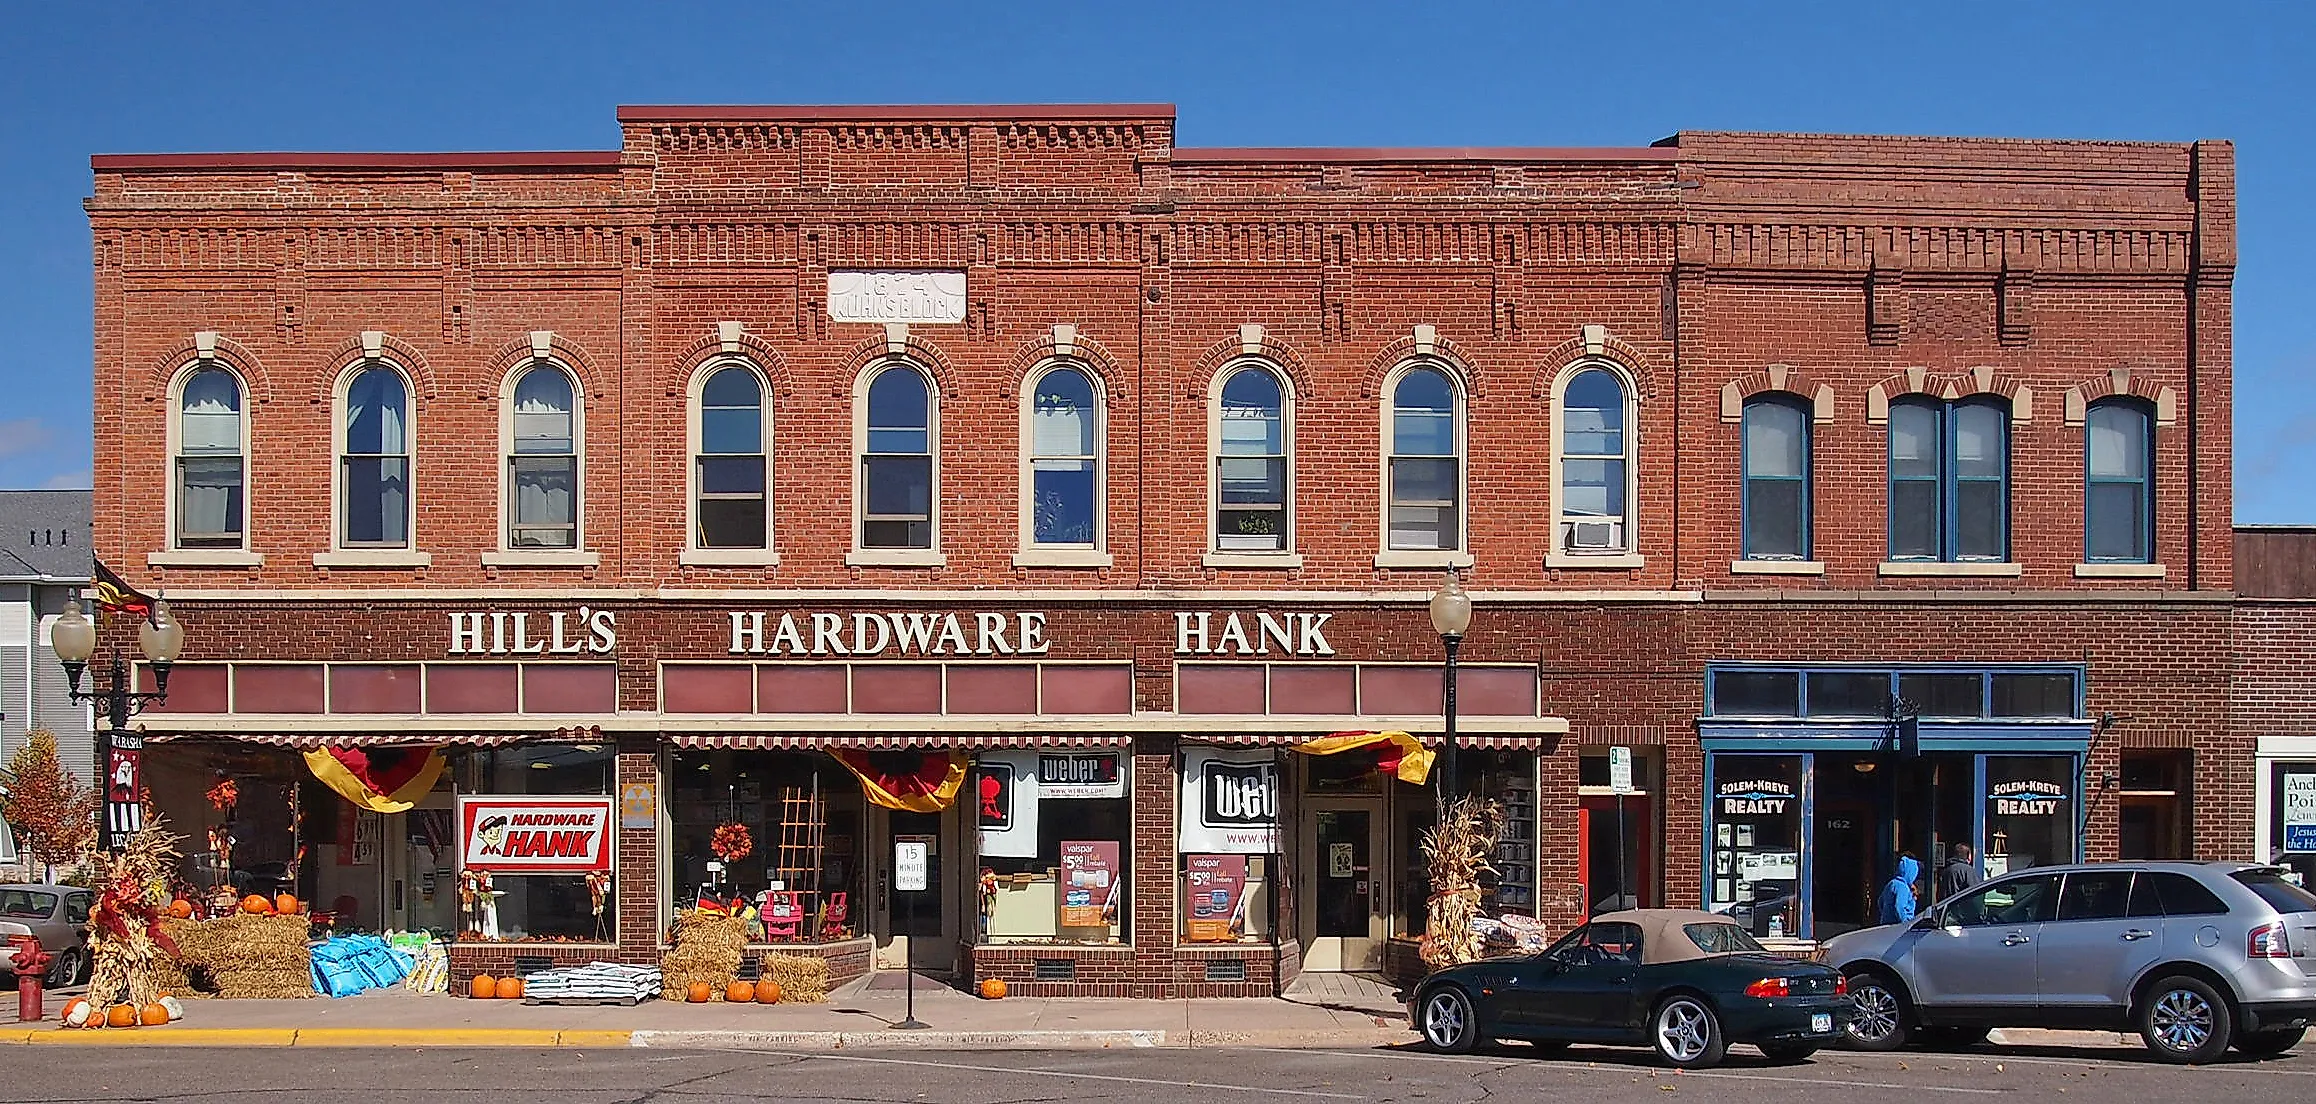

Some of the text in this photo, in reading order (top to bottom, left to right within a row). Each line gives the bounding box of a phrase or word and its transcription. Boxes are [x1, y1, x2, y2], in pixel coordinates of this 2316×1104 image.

[448, 605, 1336, 655] HILL'S HARDWARE HANK
[1043, 756, 1098, 781] weber
[1721, 780, 1790, 795] SOLEM-KREYE
[1993, 780, 2061, 795] SOLEM-KREYE
[1724, 799, 1786, 814] REALTY
[1997, 800, 2057, 815] REALTY
[511, 814, 596, 826] HARDWARE
[1827, 820, 1851, 829] 162
[502, 831, 596, 858] HANK
[1067, 844, 1094, 854] valspar
[2288, 838, 2302, 849] the
[905, 848, 918, 860] 15
[899, 864, 924, 872] MINUTE
[1192, 858, 1220, 868] valspar
